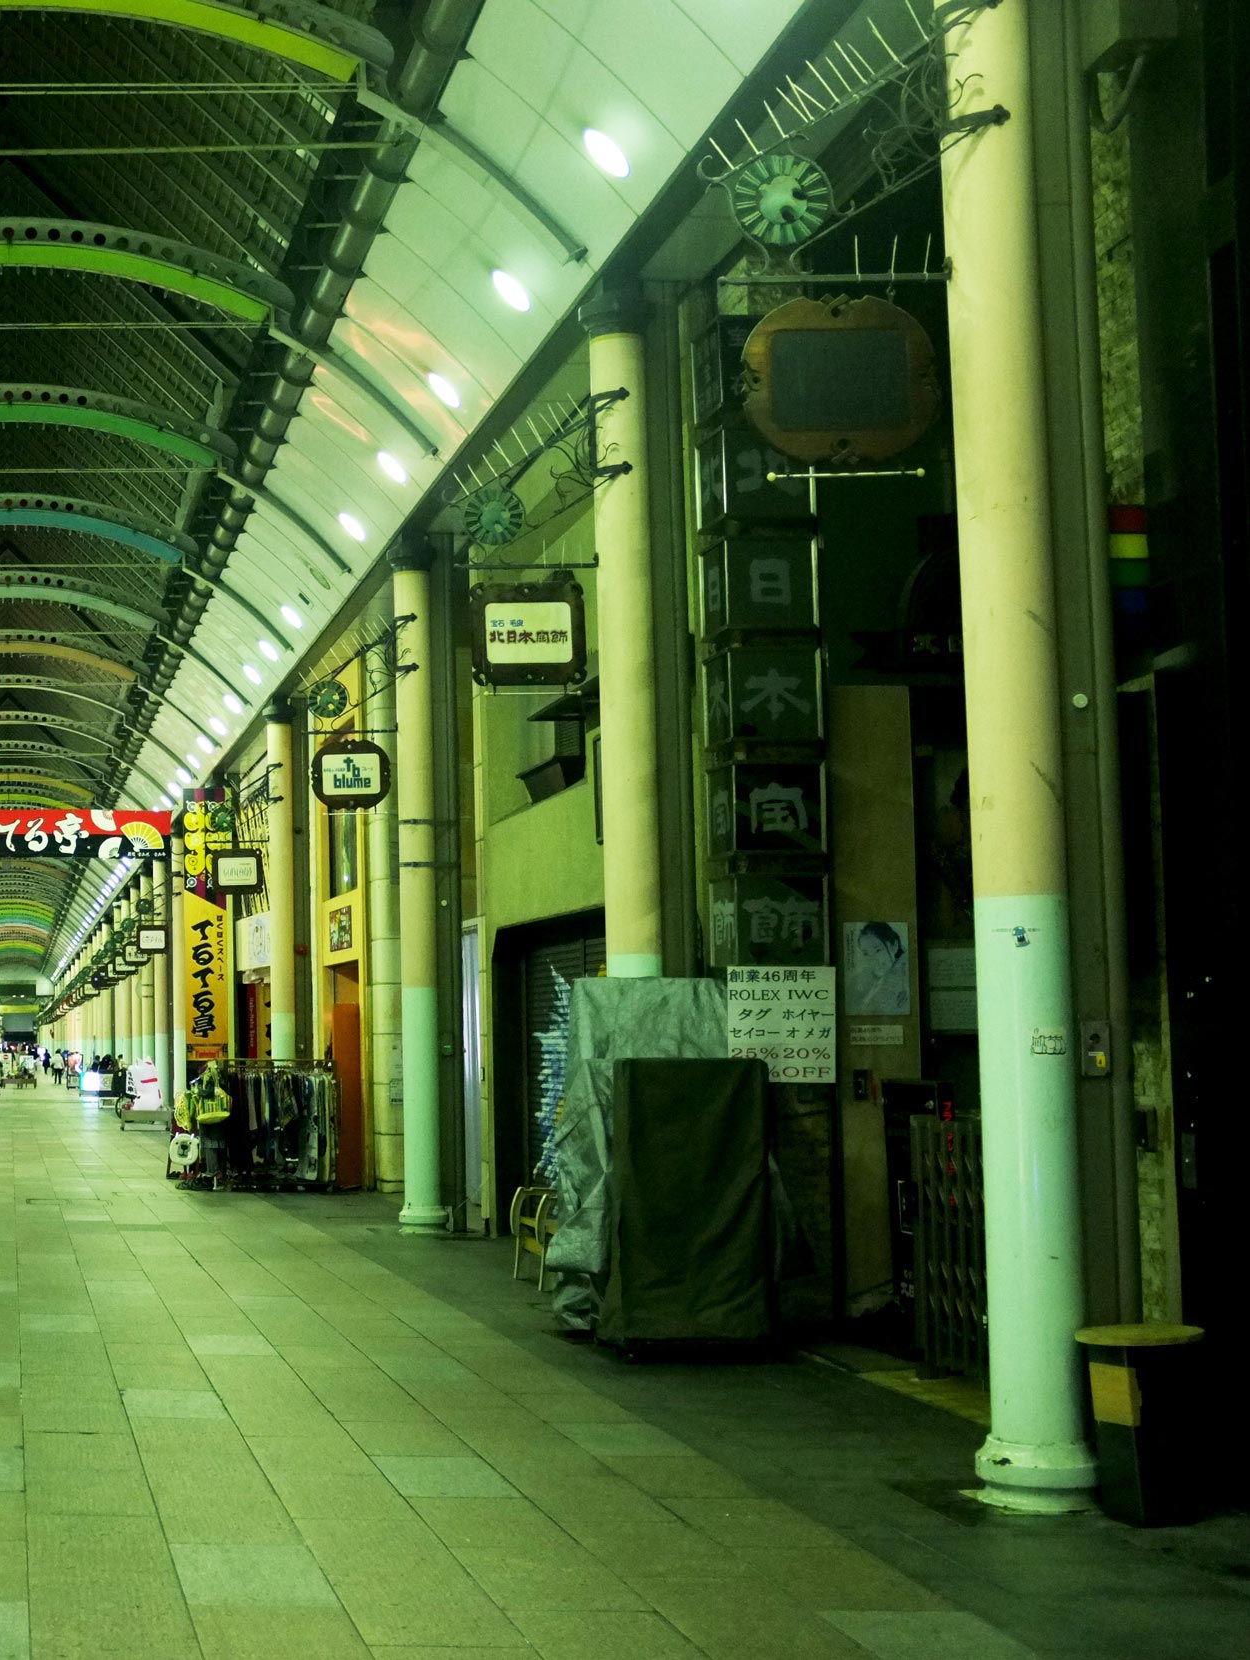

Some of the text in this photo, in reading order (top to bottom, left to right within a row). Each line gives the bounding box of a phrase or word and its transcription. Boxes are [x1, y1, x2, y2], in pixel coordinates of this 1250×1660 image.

[489, 629, 568, 644] 北日本宝飾
[333, 774, 371, 788] blume
[191, 919, 216, 1038] てるてる亭
[729, 969, 816, 983] 創業46周年
[729, 989, 829, 1001] ROLEX IWC
[738, 1007, 834, 1021] タグ ホイヤー
[729, 1027, 780, 1039] セイコー
[731, 1046, 831, 1059] 25% 20%
